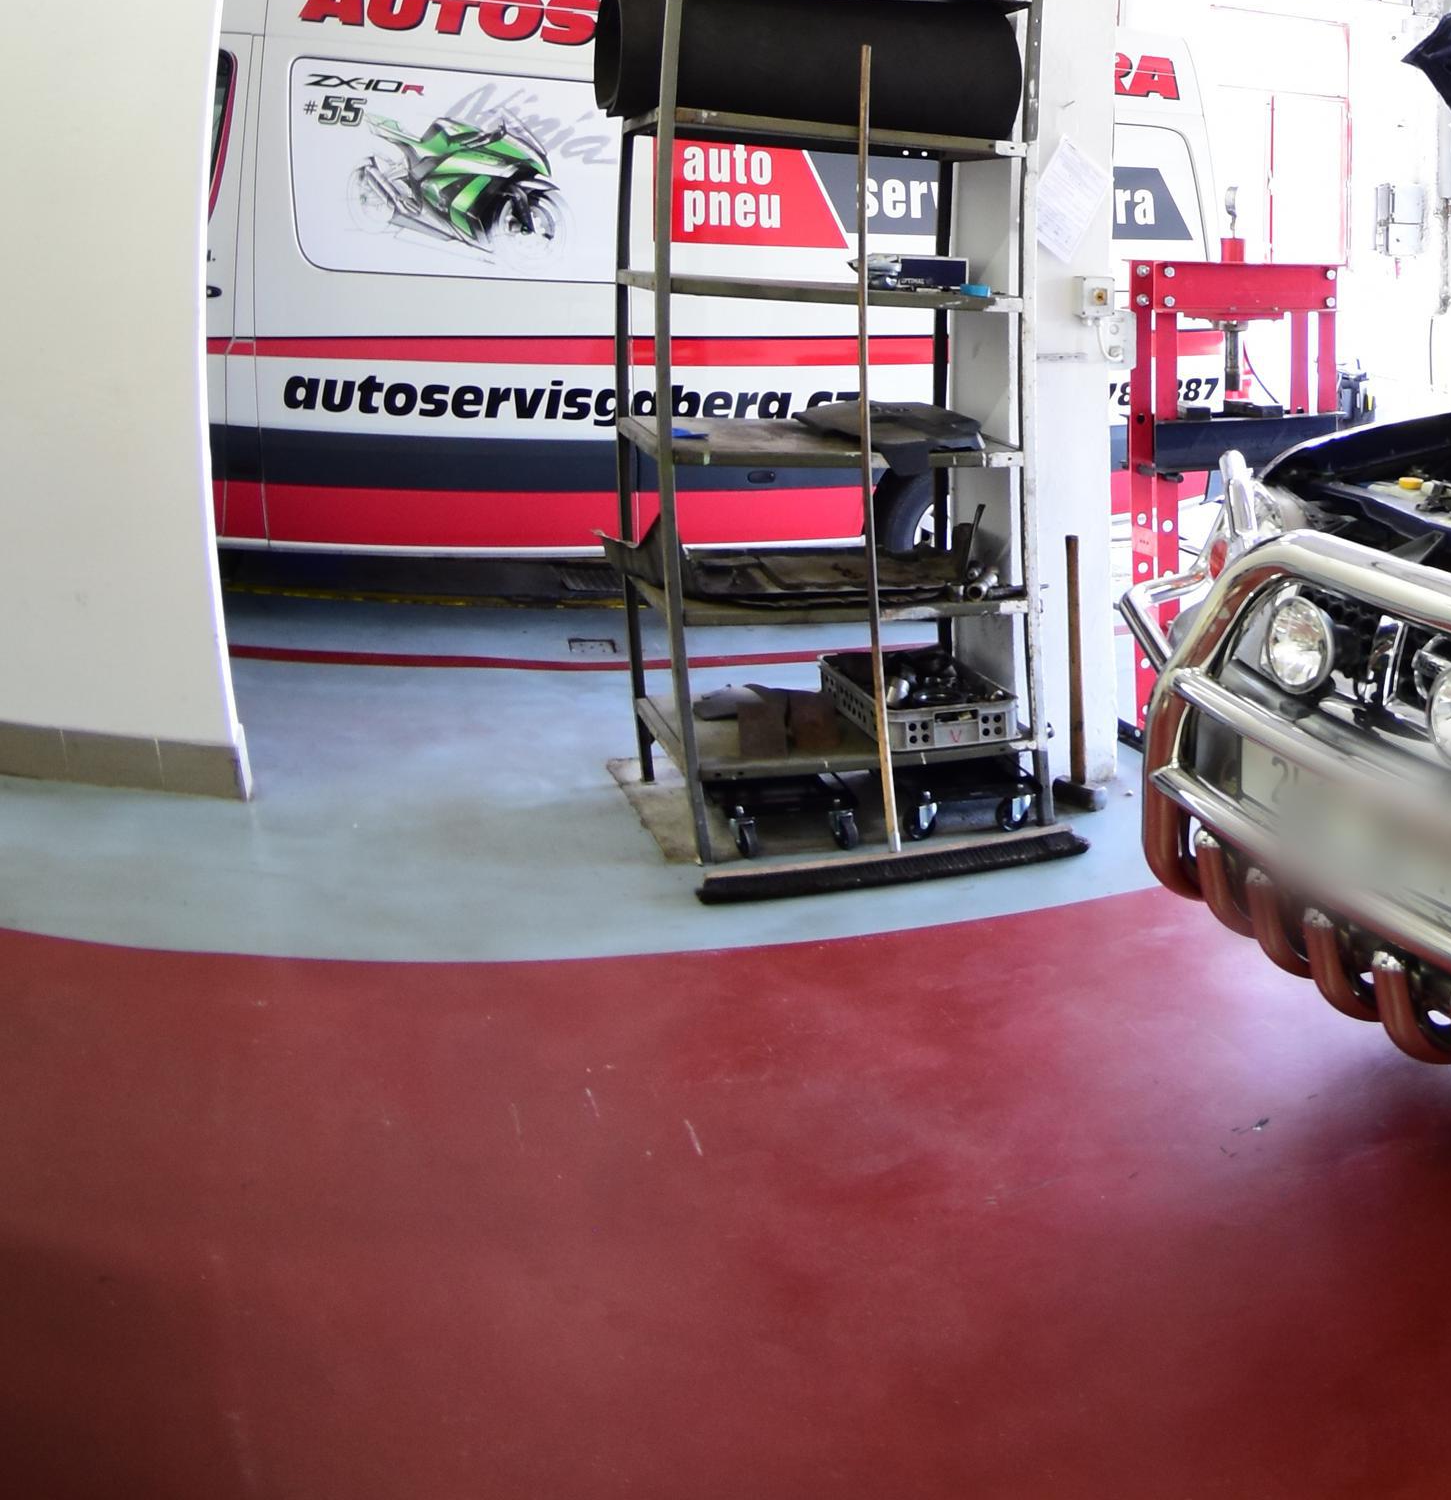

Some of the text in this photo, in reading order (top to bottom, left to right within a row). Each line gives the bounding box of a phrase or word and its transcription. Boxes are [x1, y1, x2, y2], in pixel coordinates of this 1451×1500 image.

[304, 73, 425, 96] ZX-10R
[303, 95, 368, 127] #55
[682, 144, 773, 186] auto
[682, 188, 781, 232] pneu
[1177, 377, 1219, 402] 87
